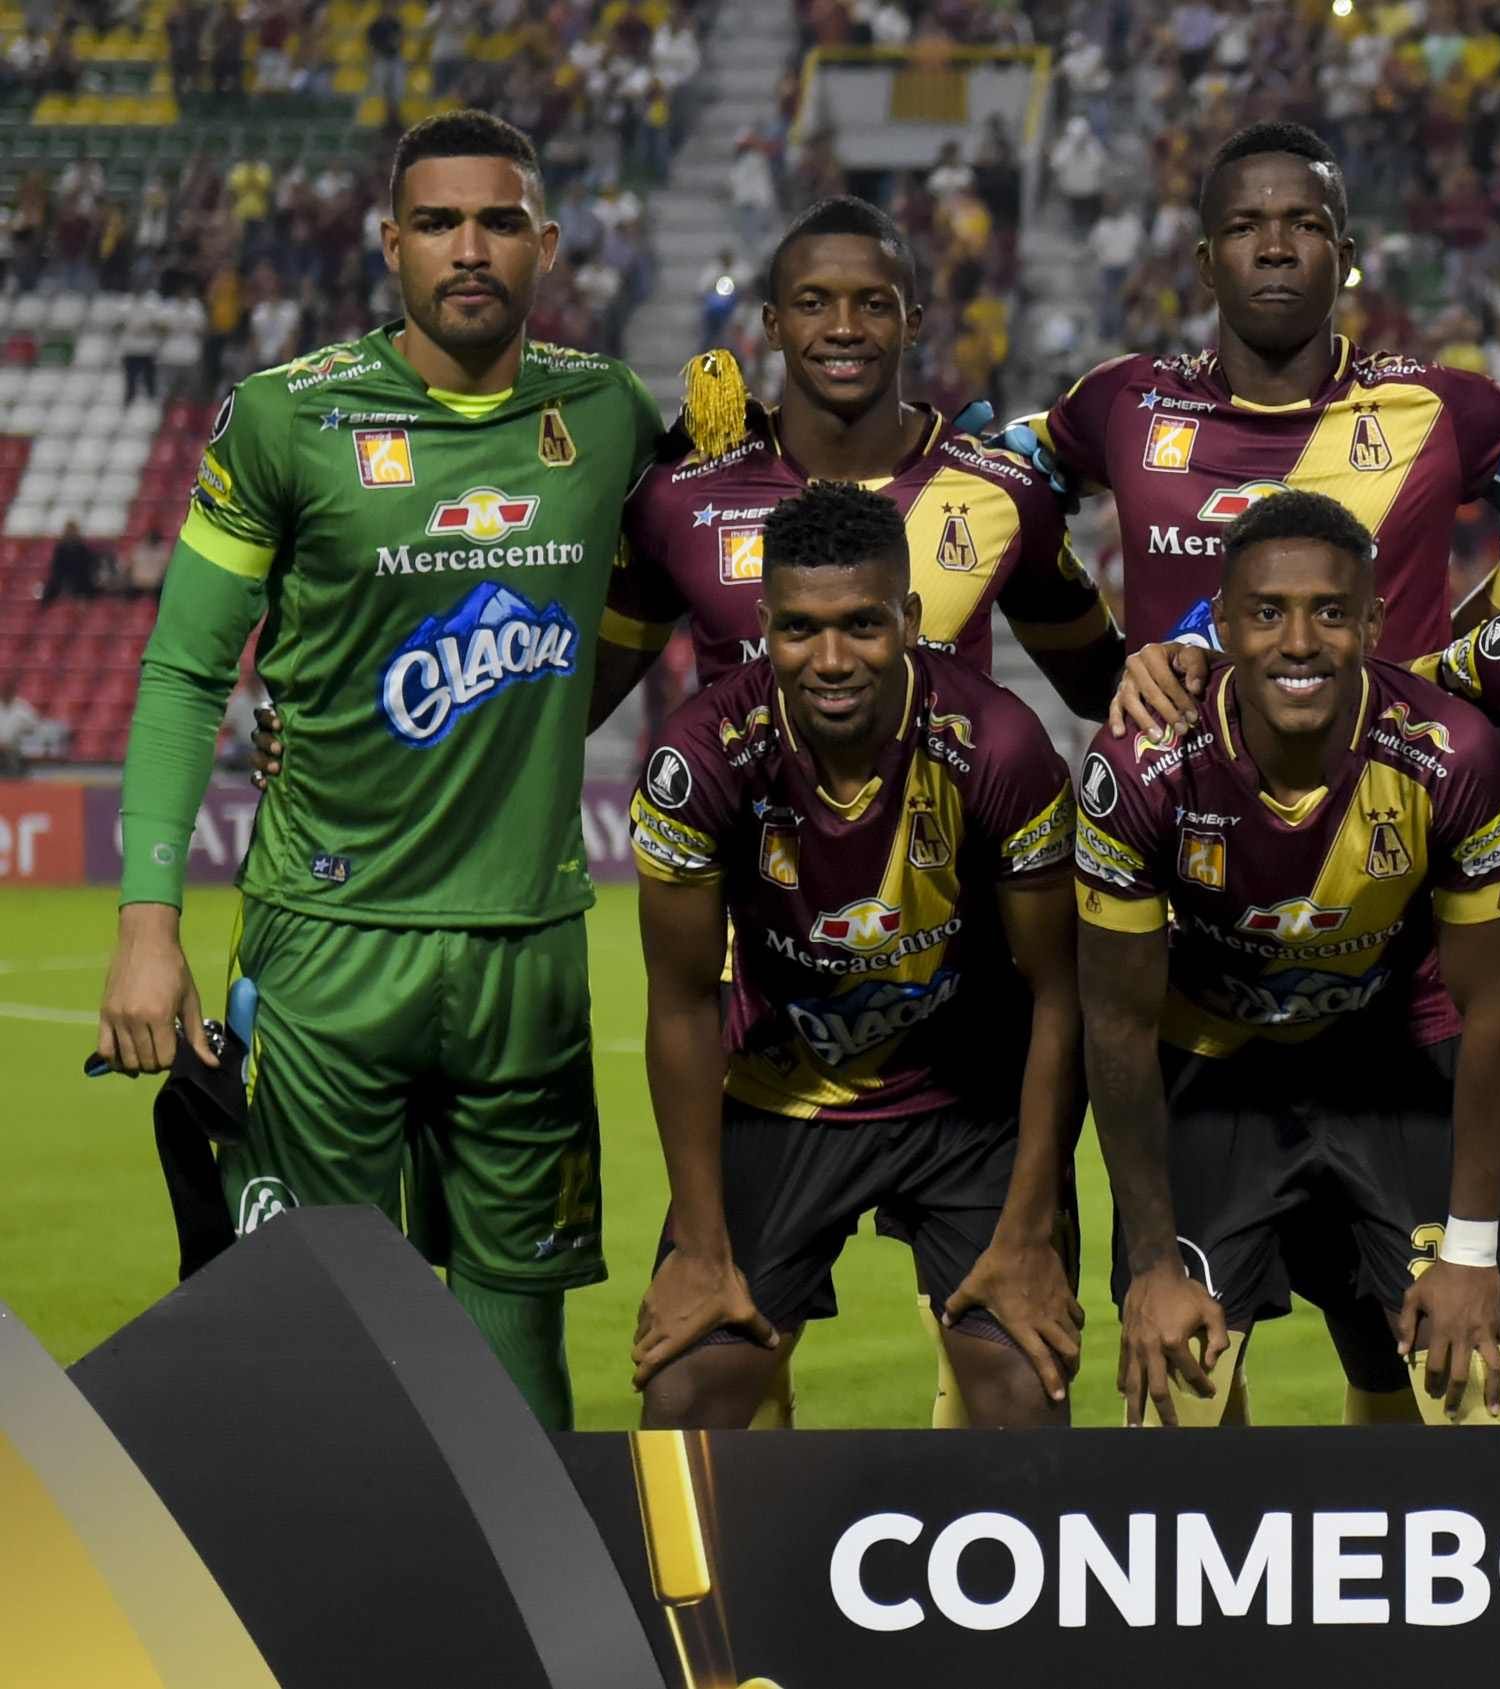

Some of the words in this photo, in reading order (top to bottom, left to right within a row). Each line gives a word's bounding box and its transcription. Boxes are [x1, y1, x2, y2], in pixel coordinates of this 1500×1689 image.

[1161, 397, 1217, 414] SHEFFY
[939, 441, 1033, 487] Multicentro
[375, 539, 584, 577] Mercacentro
[382, 622, 573, 741] GLACIAL
[1367, 727, 1448, 780] Multicentro
[766, 917, 963, 975] Mercacentro
[1192, 913, 1405, 960] Mercacentro
